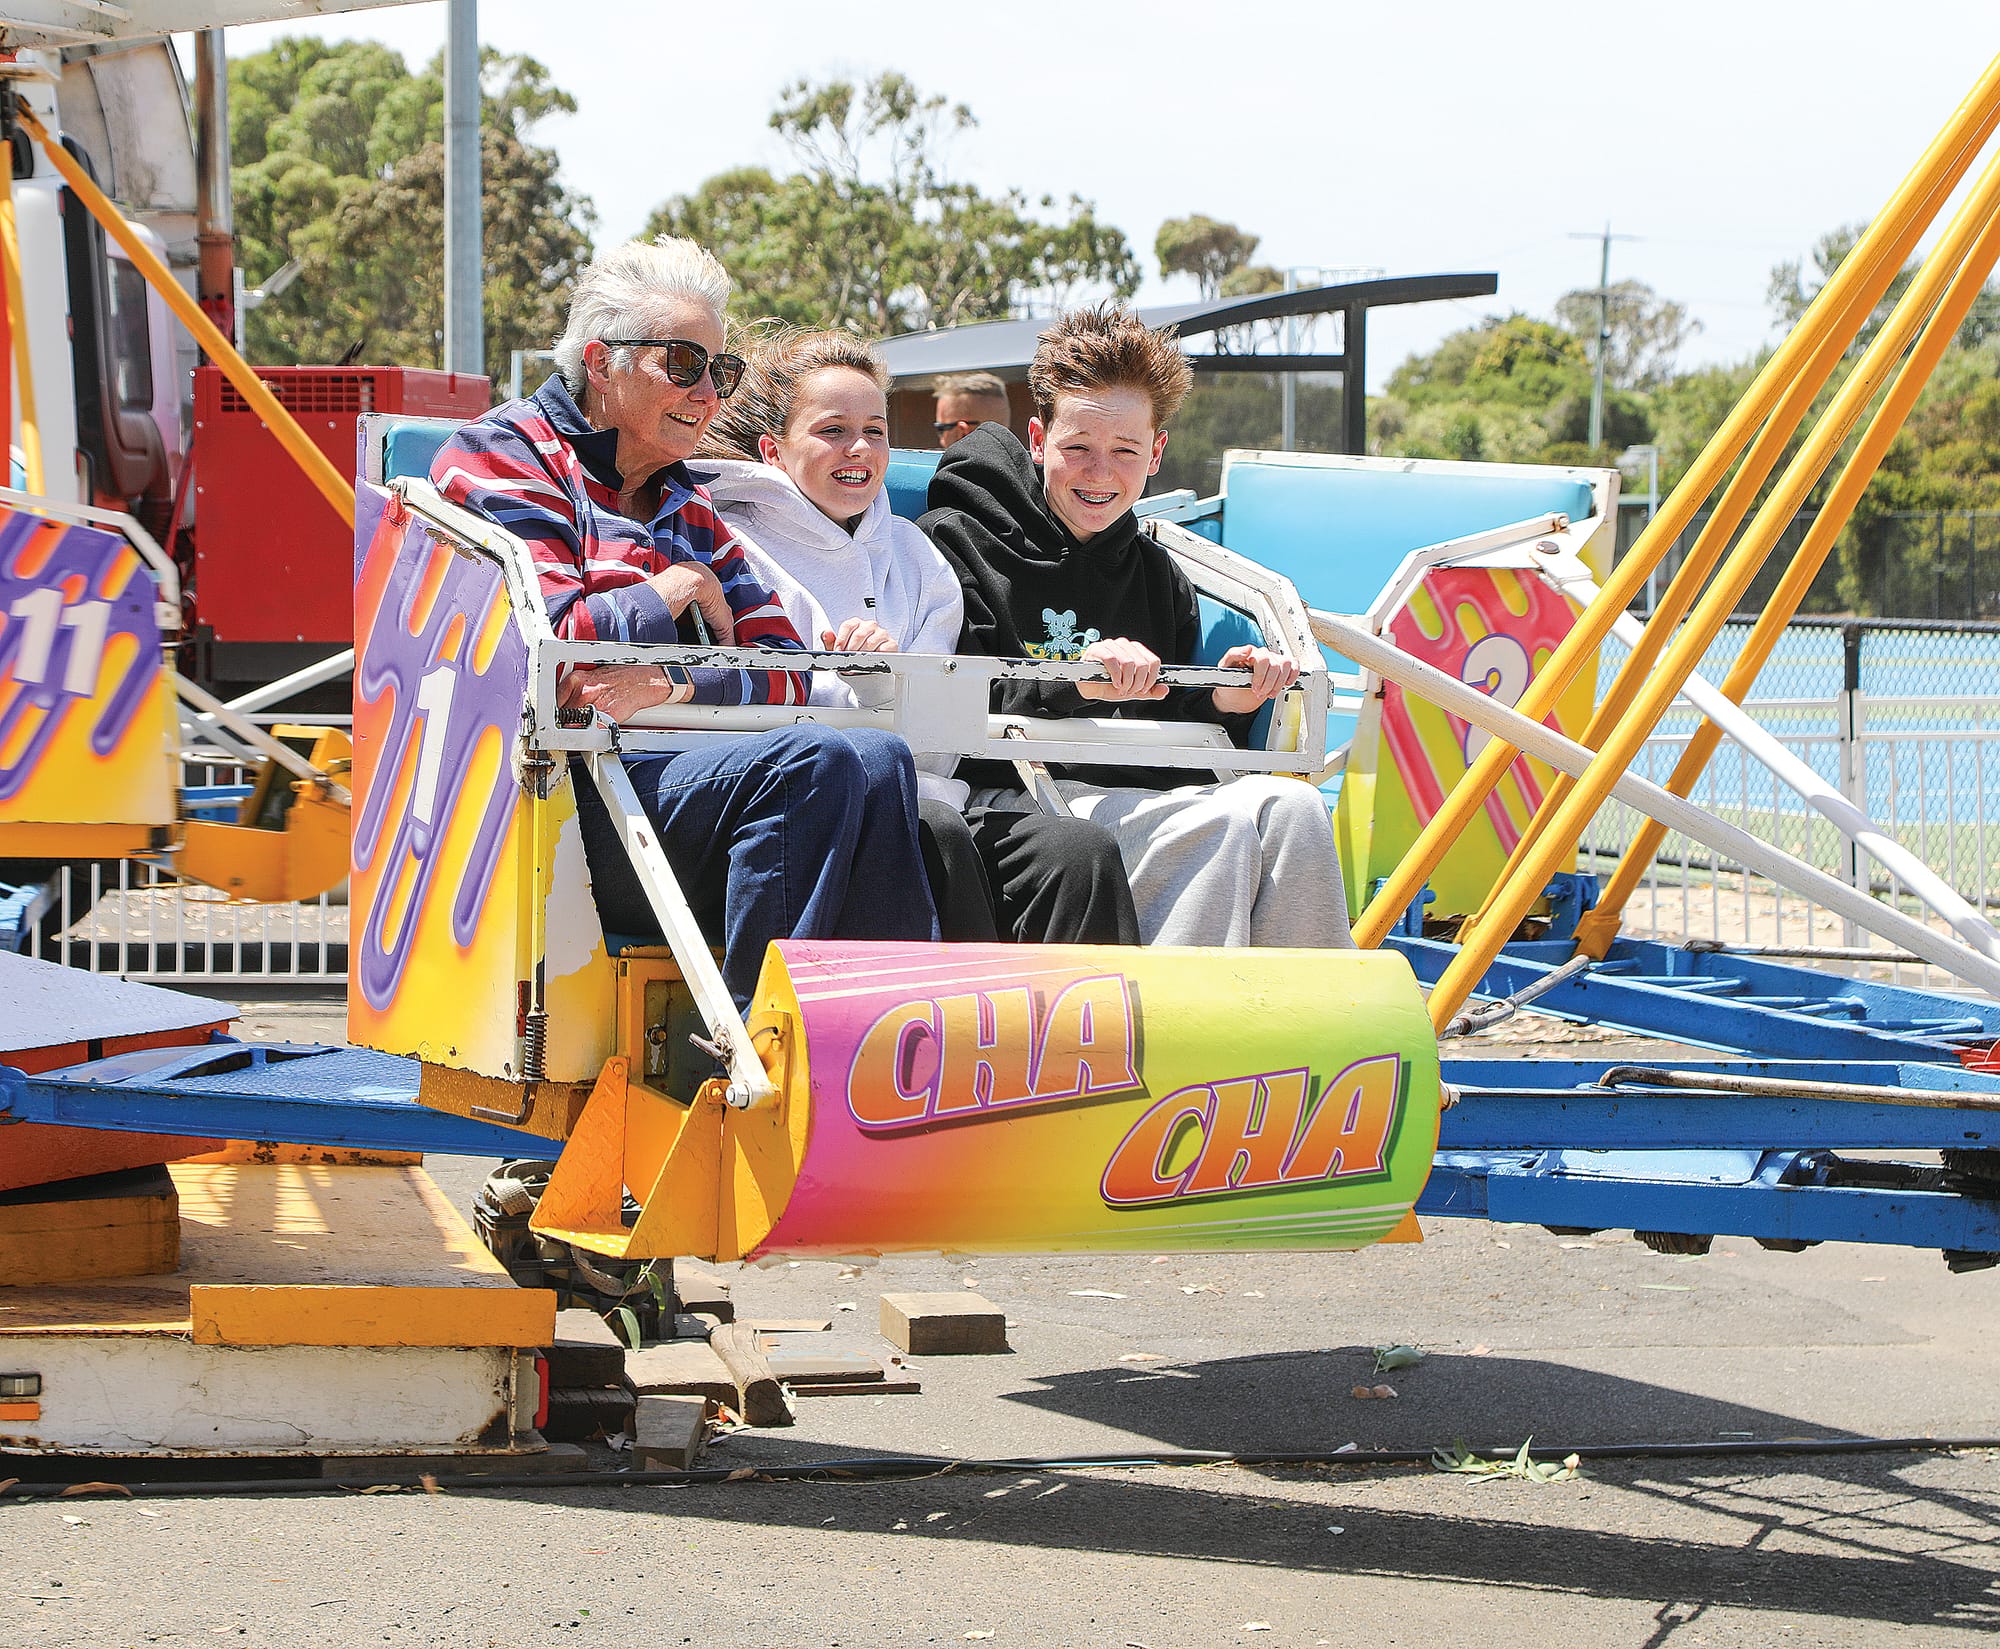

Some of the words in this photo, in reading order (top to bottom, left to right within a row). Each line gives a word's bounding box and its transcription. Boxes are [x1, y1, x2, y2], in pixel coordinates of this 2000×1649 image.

[9, 587, 113, 695] 11
[1461, 632, 1532, 770] 2
[411, 663, 459, 828] 1
[847, 973, 1144, 1132] CHA
[1100, 1053, 1402, 1206] CHA
